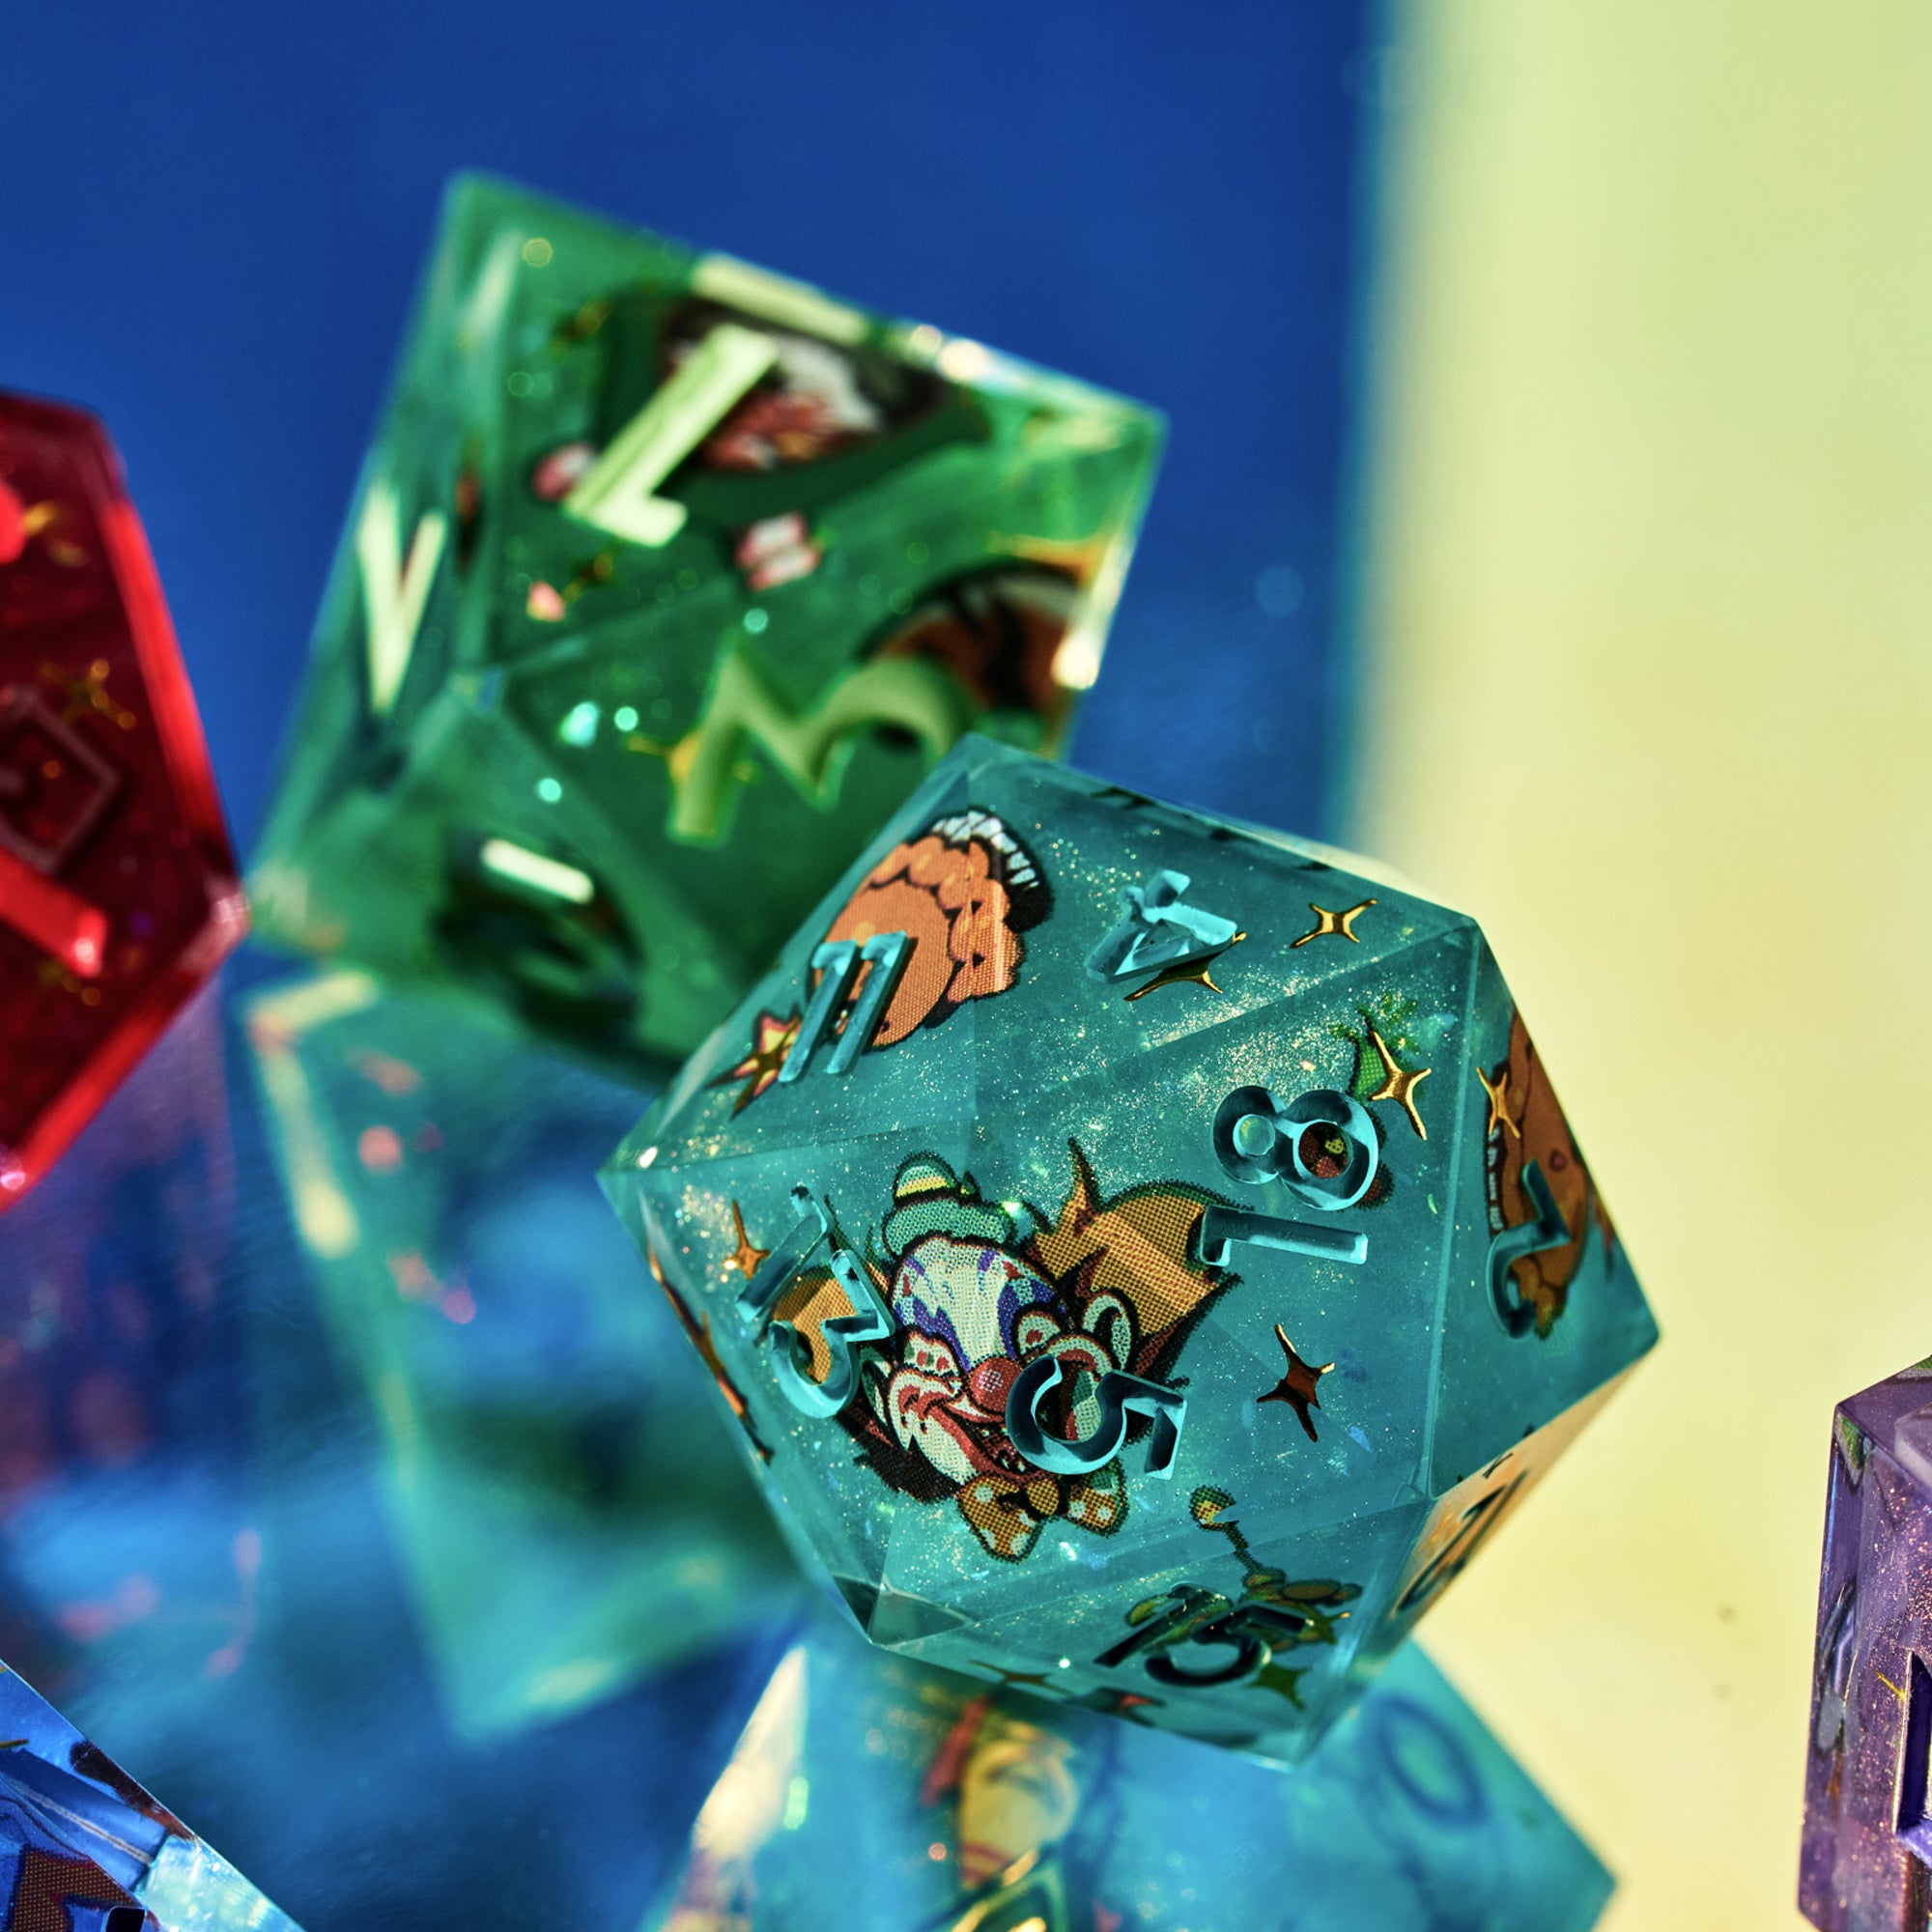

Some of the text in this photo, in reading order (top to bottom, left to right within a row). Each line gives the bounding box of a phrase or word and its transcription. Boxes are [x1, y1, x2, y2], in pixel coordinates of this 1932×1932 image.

[777, 929, 910, 1083] 11
[1083, 868, 1238, 984] 4
[1197, 1085, 1379, 1265] 18
[1485, 1157, 1573, 1340] 2
[734, 1181, 895, 1419] 13
[1004, 1354, 1189, 1481] 5
